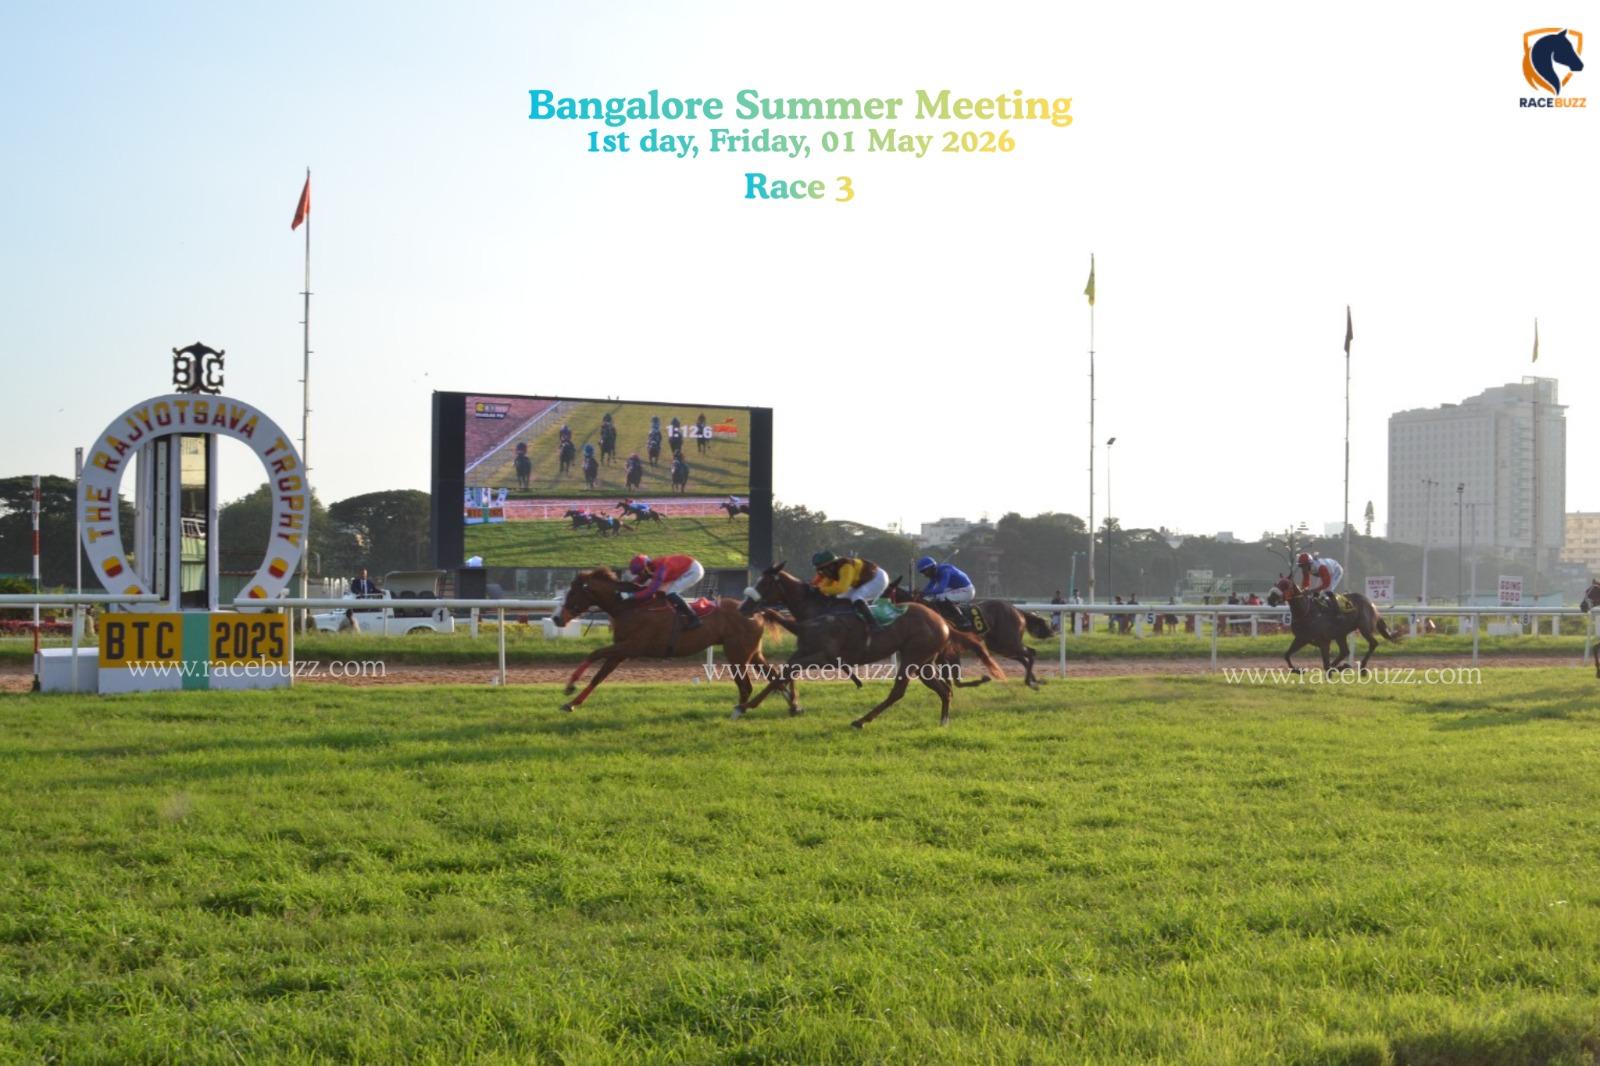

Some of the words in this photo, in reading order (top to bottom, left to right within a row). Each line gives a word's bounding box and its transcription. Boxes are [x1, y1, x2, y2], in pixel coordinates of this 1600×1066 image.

[92, 400, 260, 474] RAJYOTSAVA
[666, 424, 713, 439] 1:12.6
[86, 485, 115, 544] THE
[264, 437, 304, 548] TROPHY
[438, 609, 444, 622] 1
[106, 621, 175, 660] BTC
[215, 621, 284, 660] 2025
